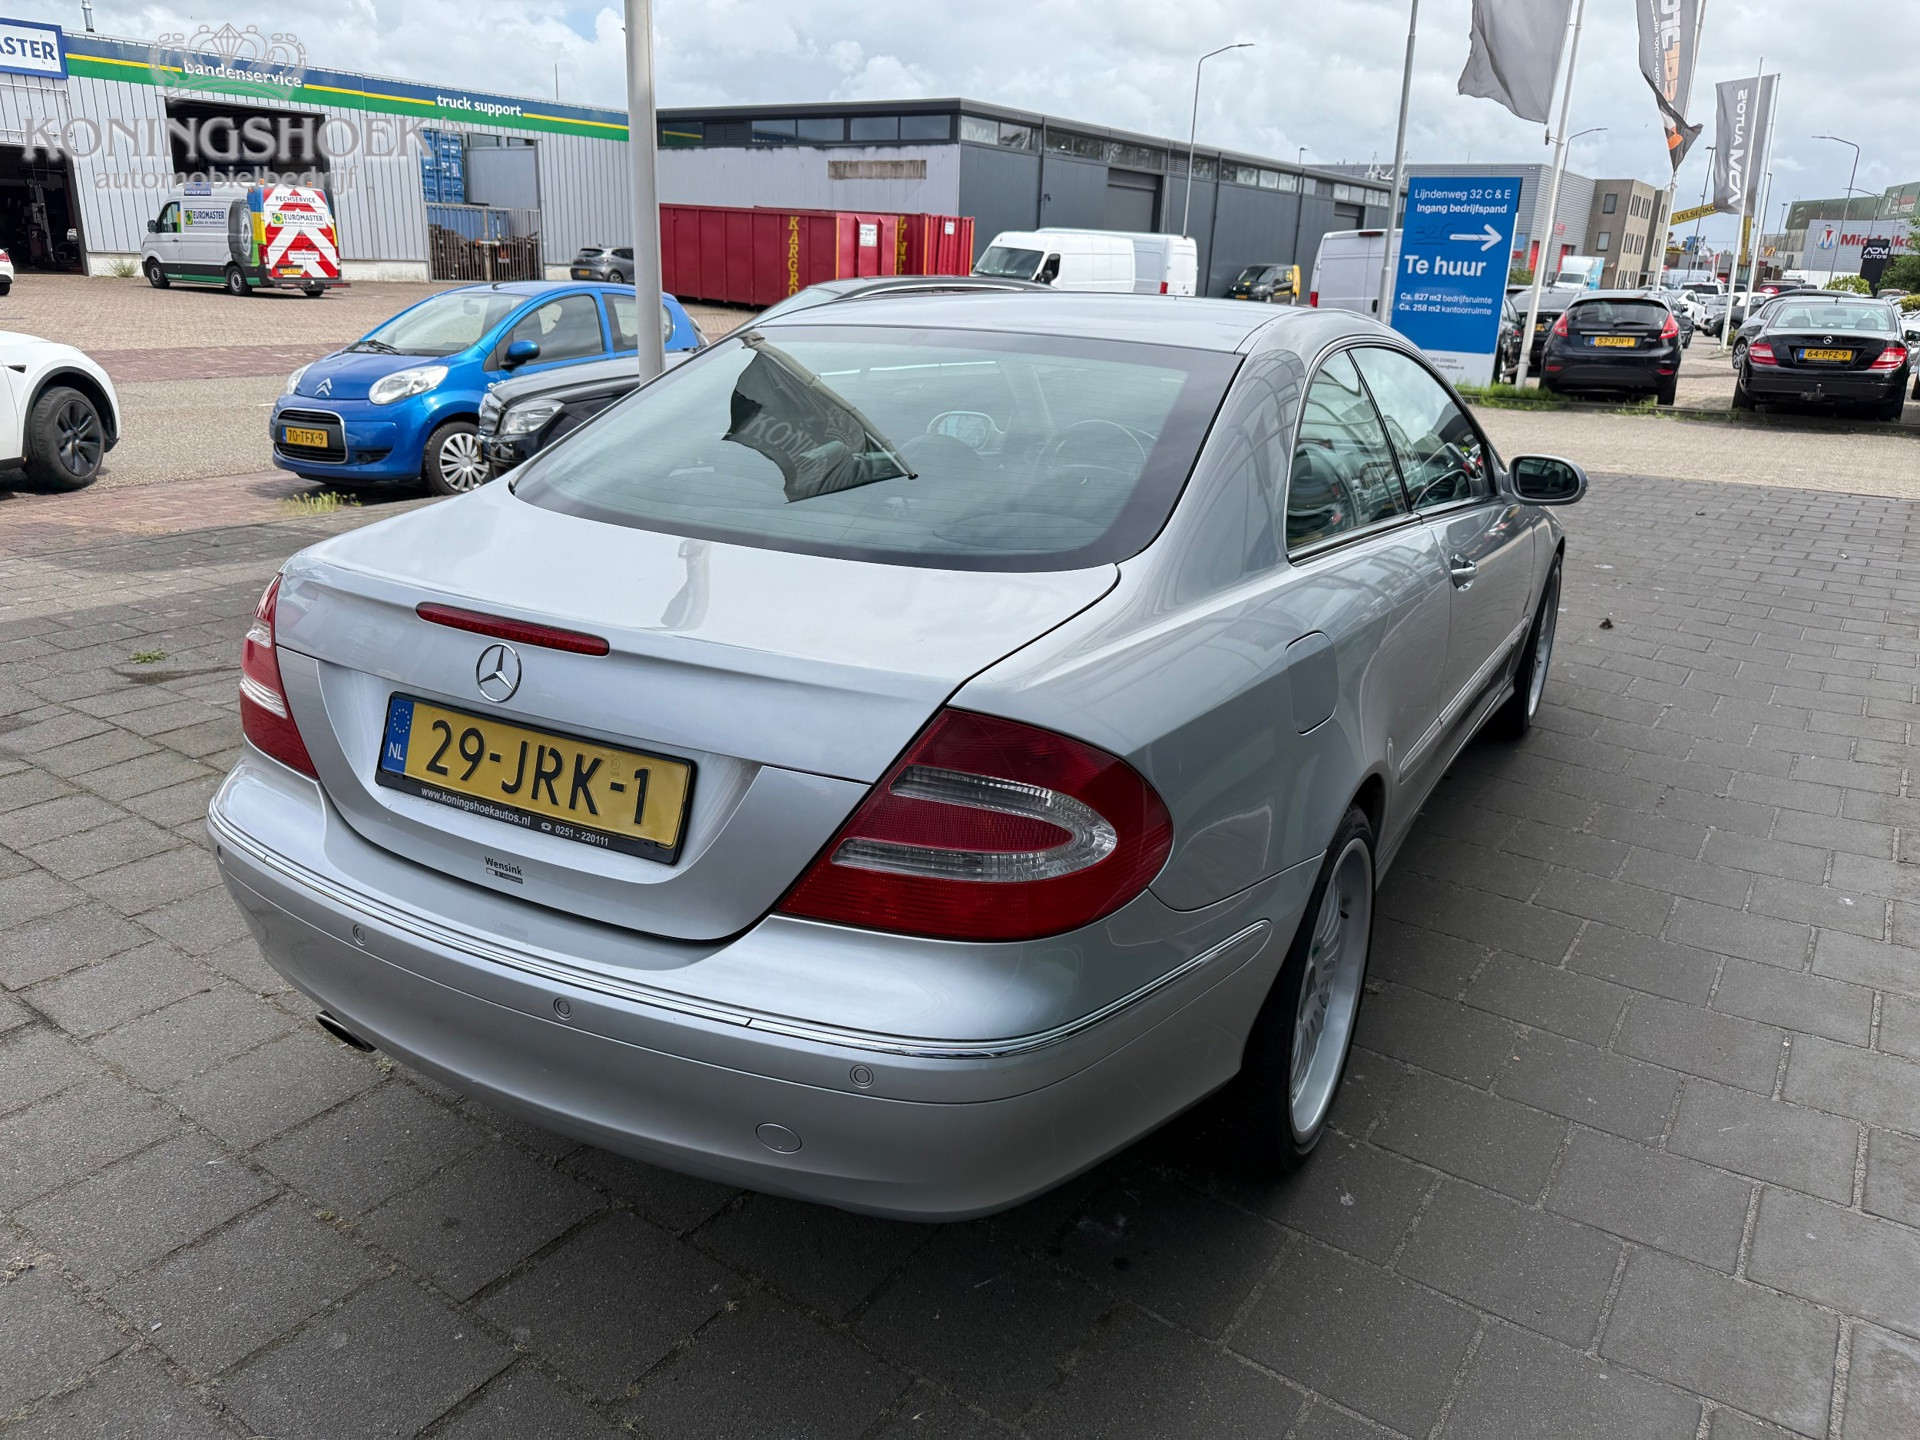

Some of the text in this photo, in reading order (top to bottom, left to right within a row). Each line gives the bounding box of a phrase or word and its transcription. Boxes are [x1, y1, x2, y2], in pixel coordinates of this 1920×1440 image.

[183, 59, 303, 88] bandenservice
[436, 95, 522, 118] truck support
[275, 195, 316, 204] PECHSERVICE
[1414, 188, 1511, 201] Lijndenweg 32 C & E
[193, 210, 225, 219] EUROMASTER
[1416, 203, 1507, 215] Ingang bedrijfspand
[283, 213, 324, 222] EUROMASTER
[1404, 255, 1487, 277] Te huur
[1400, 292, 1493, 305] Ca. 827 m2 bedrijfsruimte
[1399, 303, 1492, 316] Ca. 258 m2 kantoorruimte
[1807, 349, 1848, 359] 64-PFZ-9
[287, 428, 324, 445] 70-TFX-9
[388, 741, 404, 762] NL
[426, 719, 650, 825] 29-JRK-1
[421, 786, 531, 827] www.koningshoekautos.nl
[554, 824, 574, 838] 0251
[581, 830, 609, 846] 220111
[484, 856, 523, 877] Wensink
